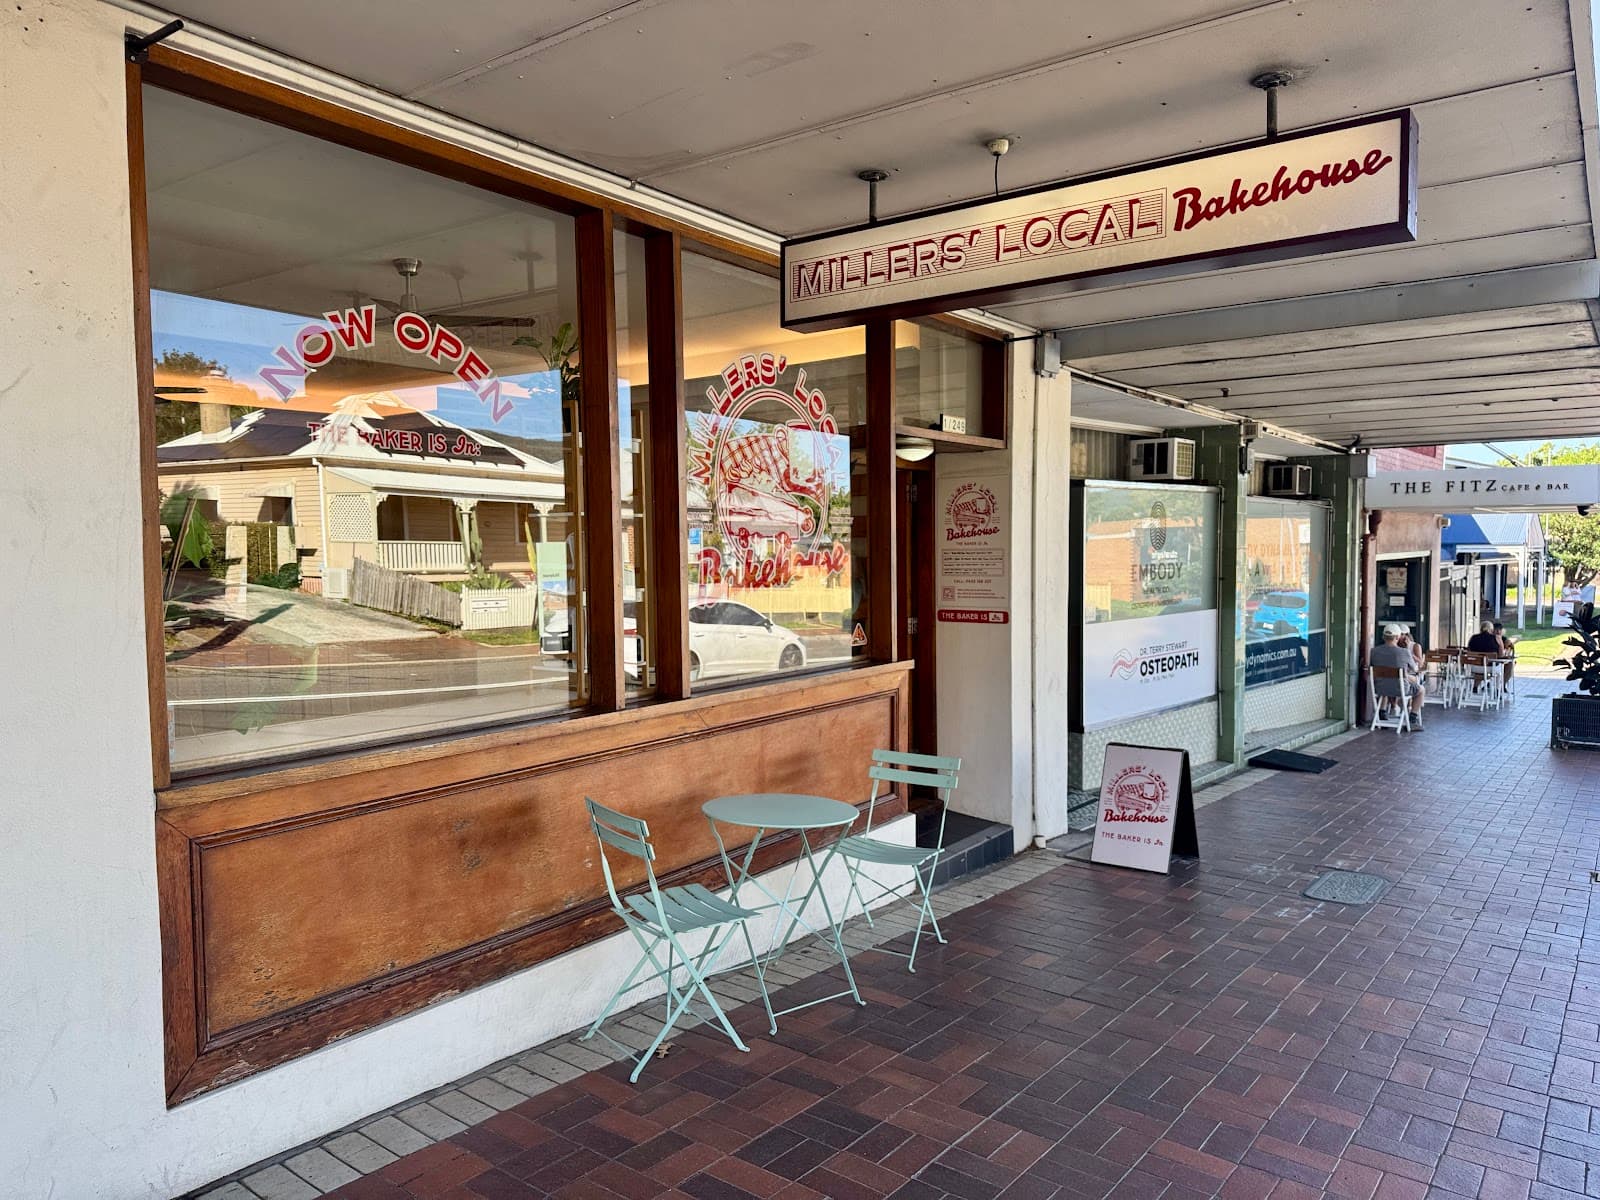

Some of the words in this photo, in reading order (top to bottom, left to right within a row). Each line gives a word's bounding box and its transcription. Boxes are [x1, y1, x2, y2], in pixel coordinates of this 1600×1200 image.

[798, 231, 982, 298] MILLERS'
[995, 200, 1161, 262] LOCAL
[1173, 146, 1393, 232] Bakehouse
[258, 304, 376, 403] NOW
[393, 312, 514, 424] OPEN
[688, 353, 788, 488] MILLERS'
[794, 368, 847, 492] LOCAL
[307, 421, 350, 442] THE
[357, 428, 424, 452] BAKER
[428, 433, 447, 453] IS
[1390, 482, 1432, 494] THE
[1445, 479, 1497, 493] FITZ
[1501, 482, 1530, 491] CAFE
[1547, 483, 1570, 491] BAR
[946, 526, 1000, 541] Bakehouse
[698, 546, 848, 607] Bakehouse
[1130, 561, 1182, 582] EMBODY
[1166, 641, 1188, 652] STEWART
[1140, 651, 1199, 677] OSTEOPATH
[1103, 808, 1168, 823] Bakehouse
[1101, 831, 1115, 839] THE
[1117, 834, 1141, 842] BAKER
